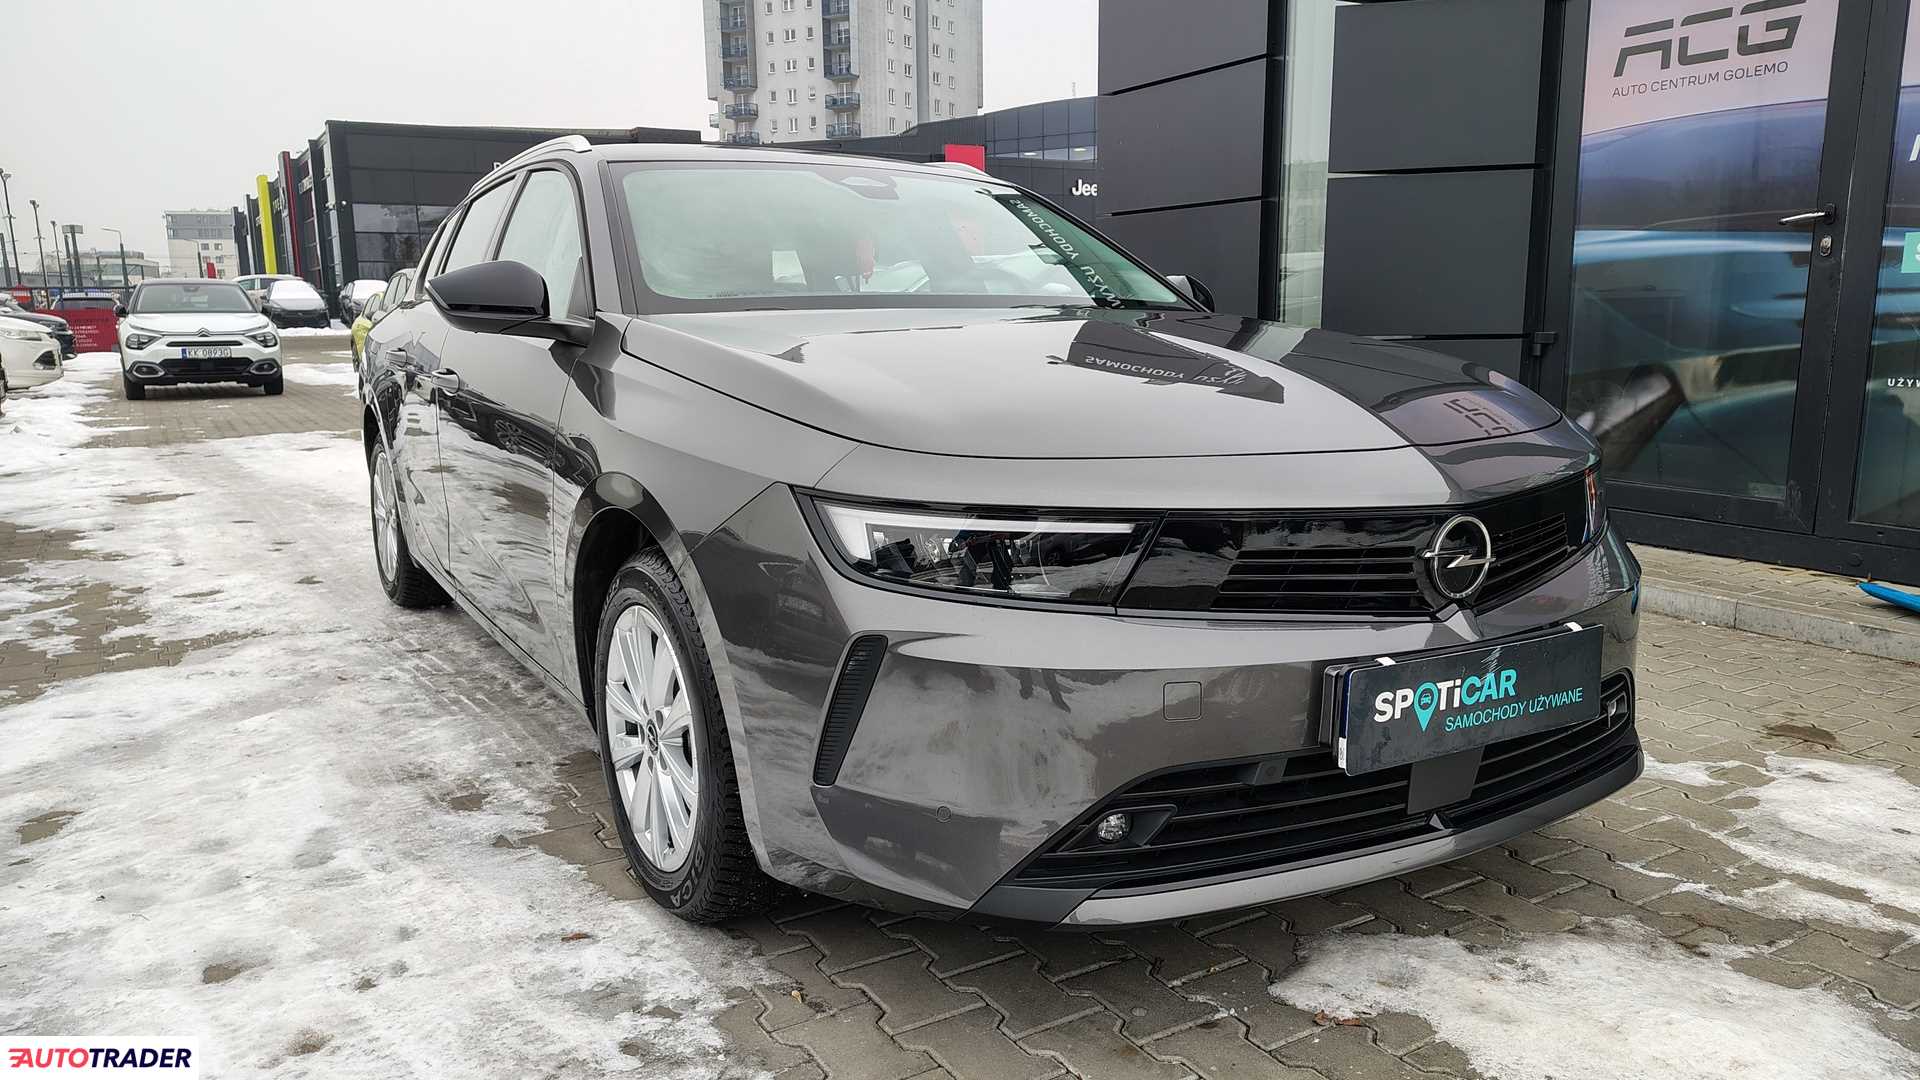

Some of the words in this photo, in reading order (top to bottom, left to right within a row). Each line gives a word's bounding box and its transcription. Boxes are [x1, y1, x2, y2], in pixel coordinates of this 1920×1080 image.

[1613, 0, 1807, 78] ACG
[1612, 83, 1648, 98] AUTO
[1650, 71, 1720, 92] CENTRUM
[1723, 61, 1789, 81] GOLEMO
[1445, 702, 1527, 732] SAMOCHODY
[1529, 687, 1583, 713] UŻYWANE
